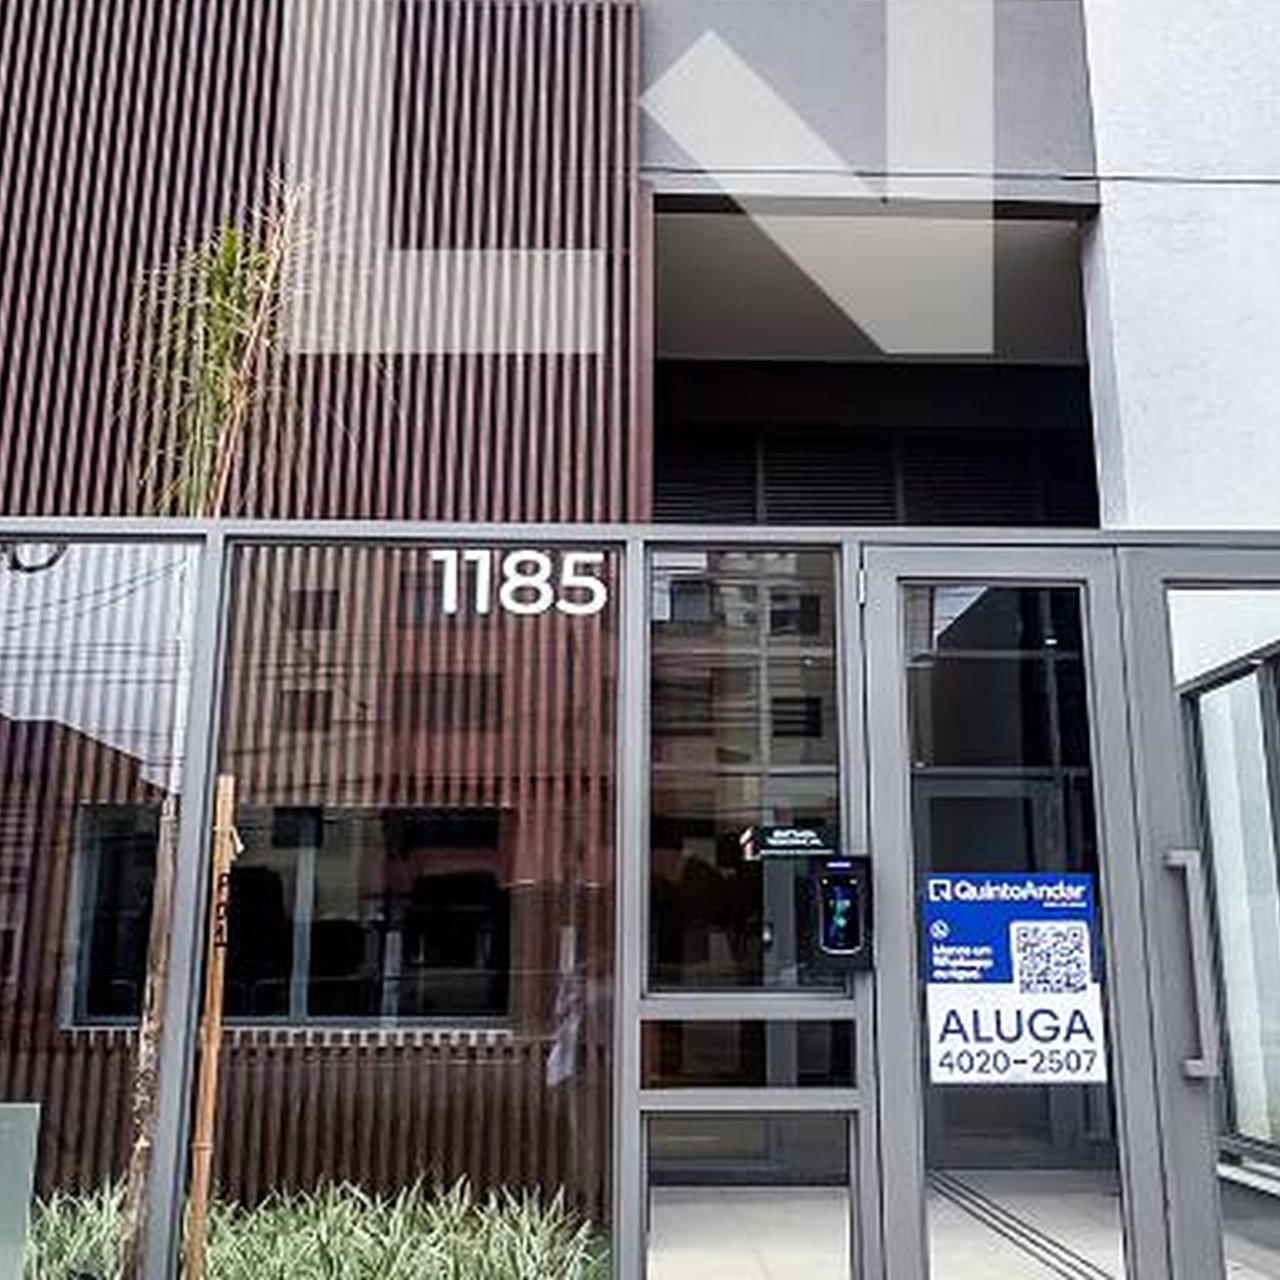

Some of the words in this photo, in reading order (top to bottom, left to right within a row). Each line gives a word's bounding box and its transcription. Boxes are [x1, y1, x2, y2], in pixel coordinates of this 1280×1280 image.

[431, 549, 609, 616] 1185
[954, 874, 1087, 901] QuintoAndar
[939, 1008, 1095, 1043] ALUGA
[938, 1049, 1097, 1074] 4020-2507
